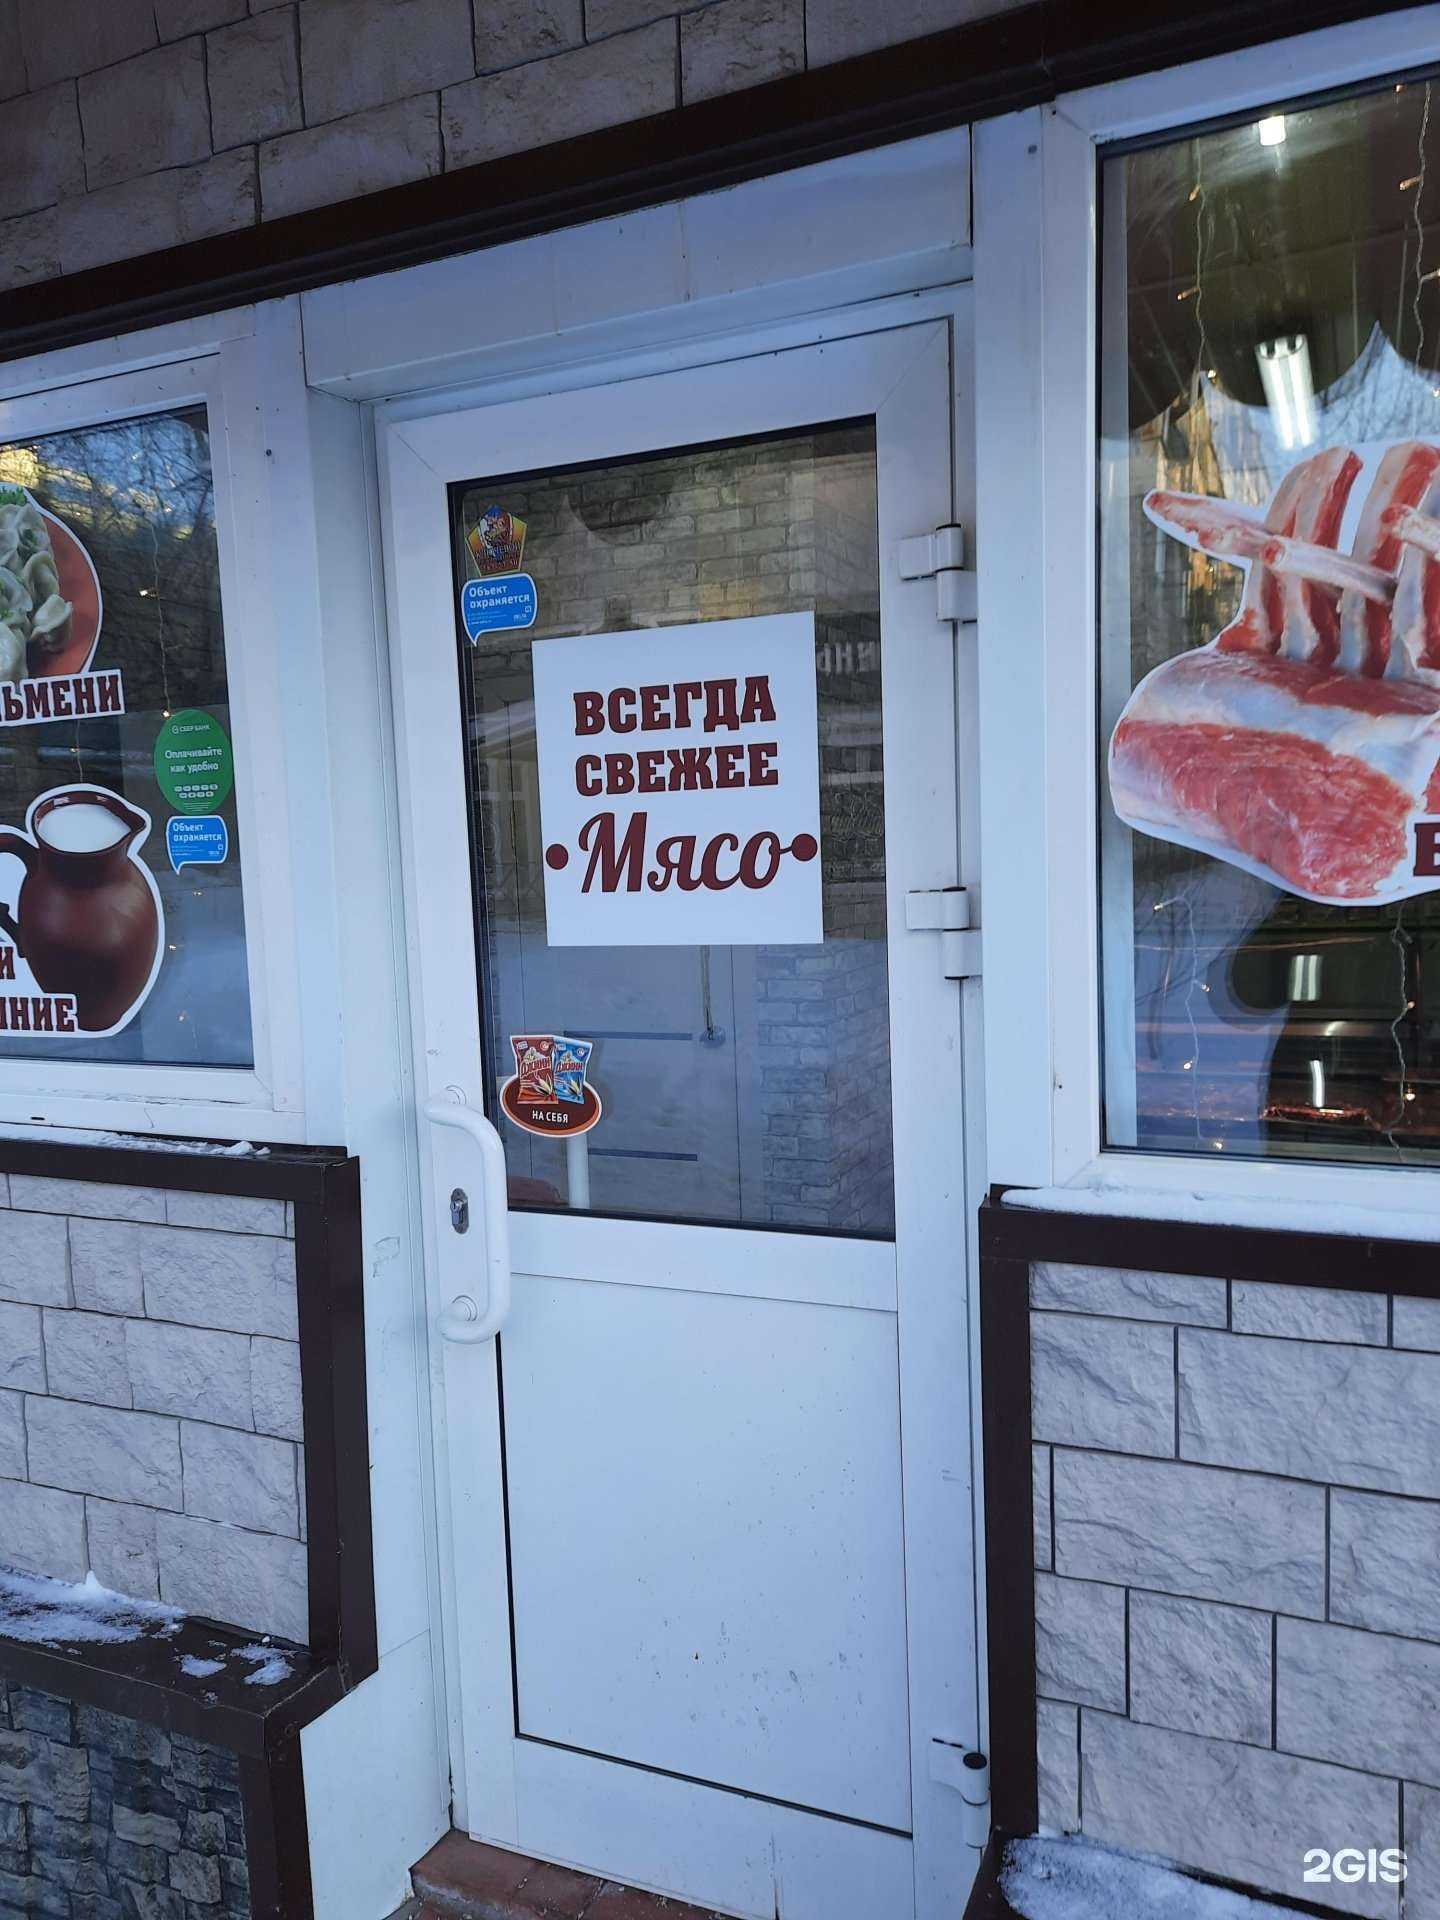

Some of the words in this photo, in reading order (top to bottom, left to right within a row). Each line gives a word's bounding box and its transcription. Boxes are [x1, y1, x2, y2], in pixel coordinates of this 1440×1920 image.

[469, 585, 508, 598] Объект
[470, 594, 530, 610] охраняется
[0, 674, 121, 722] ЬМЕНИ
[573, 675, 777, 736] ВСЕГДА
[164, 747, 223, 759] Оплачивайте
[170, 764, 186, 773] как
[187, 761, 219, 774] удобно
[575, 742, 779, 797] СВЕЖЕЕ
[173, 823, 204, 832] Объект
[173, 832, 222, 844] охраняется
[578, 811, 784, 893] Мясо
[532, 1110, 544, 1121] НА
[546, 1112, 569, 1123] СЕБЯ
